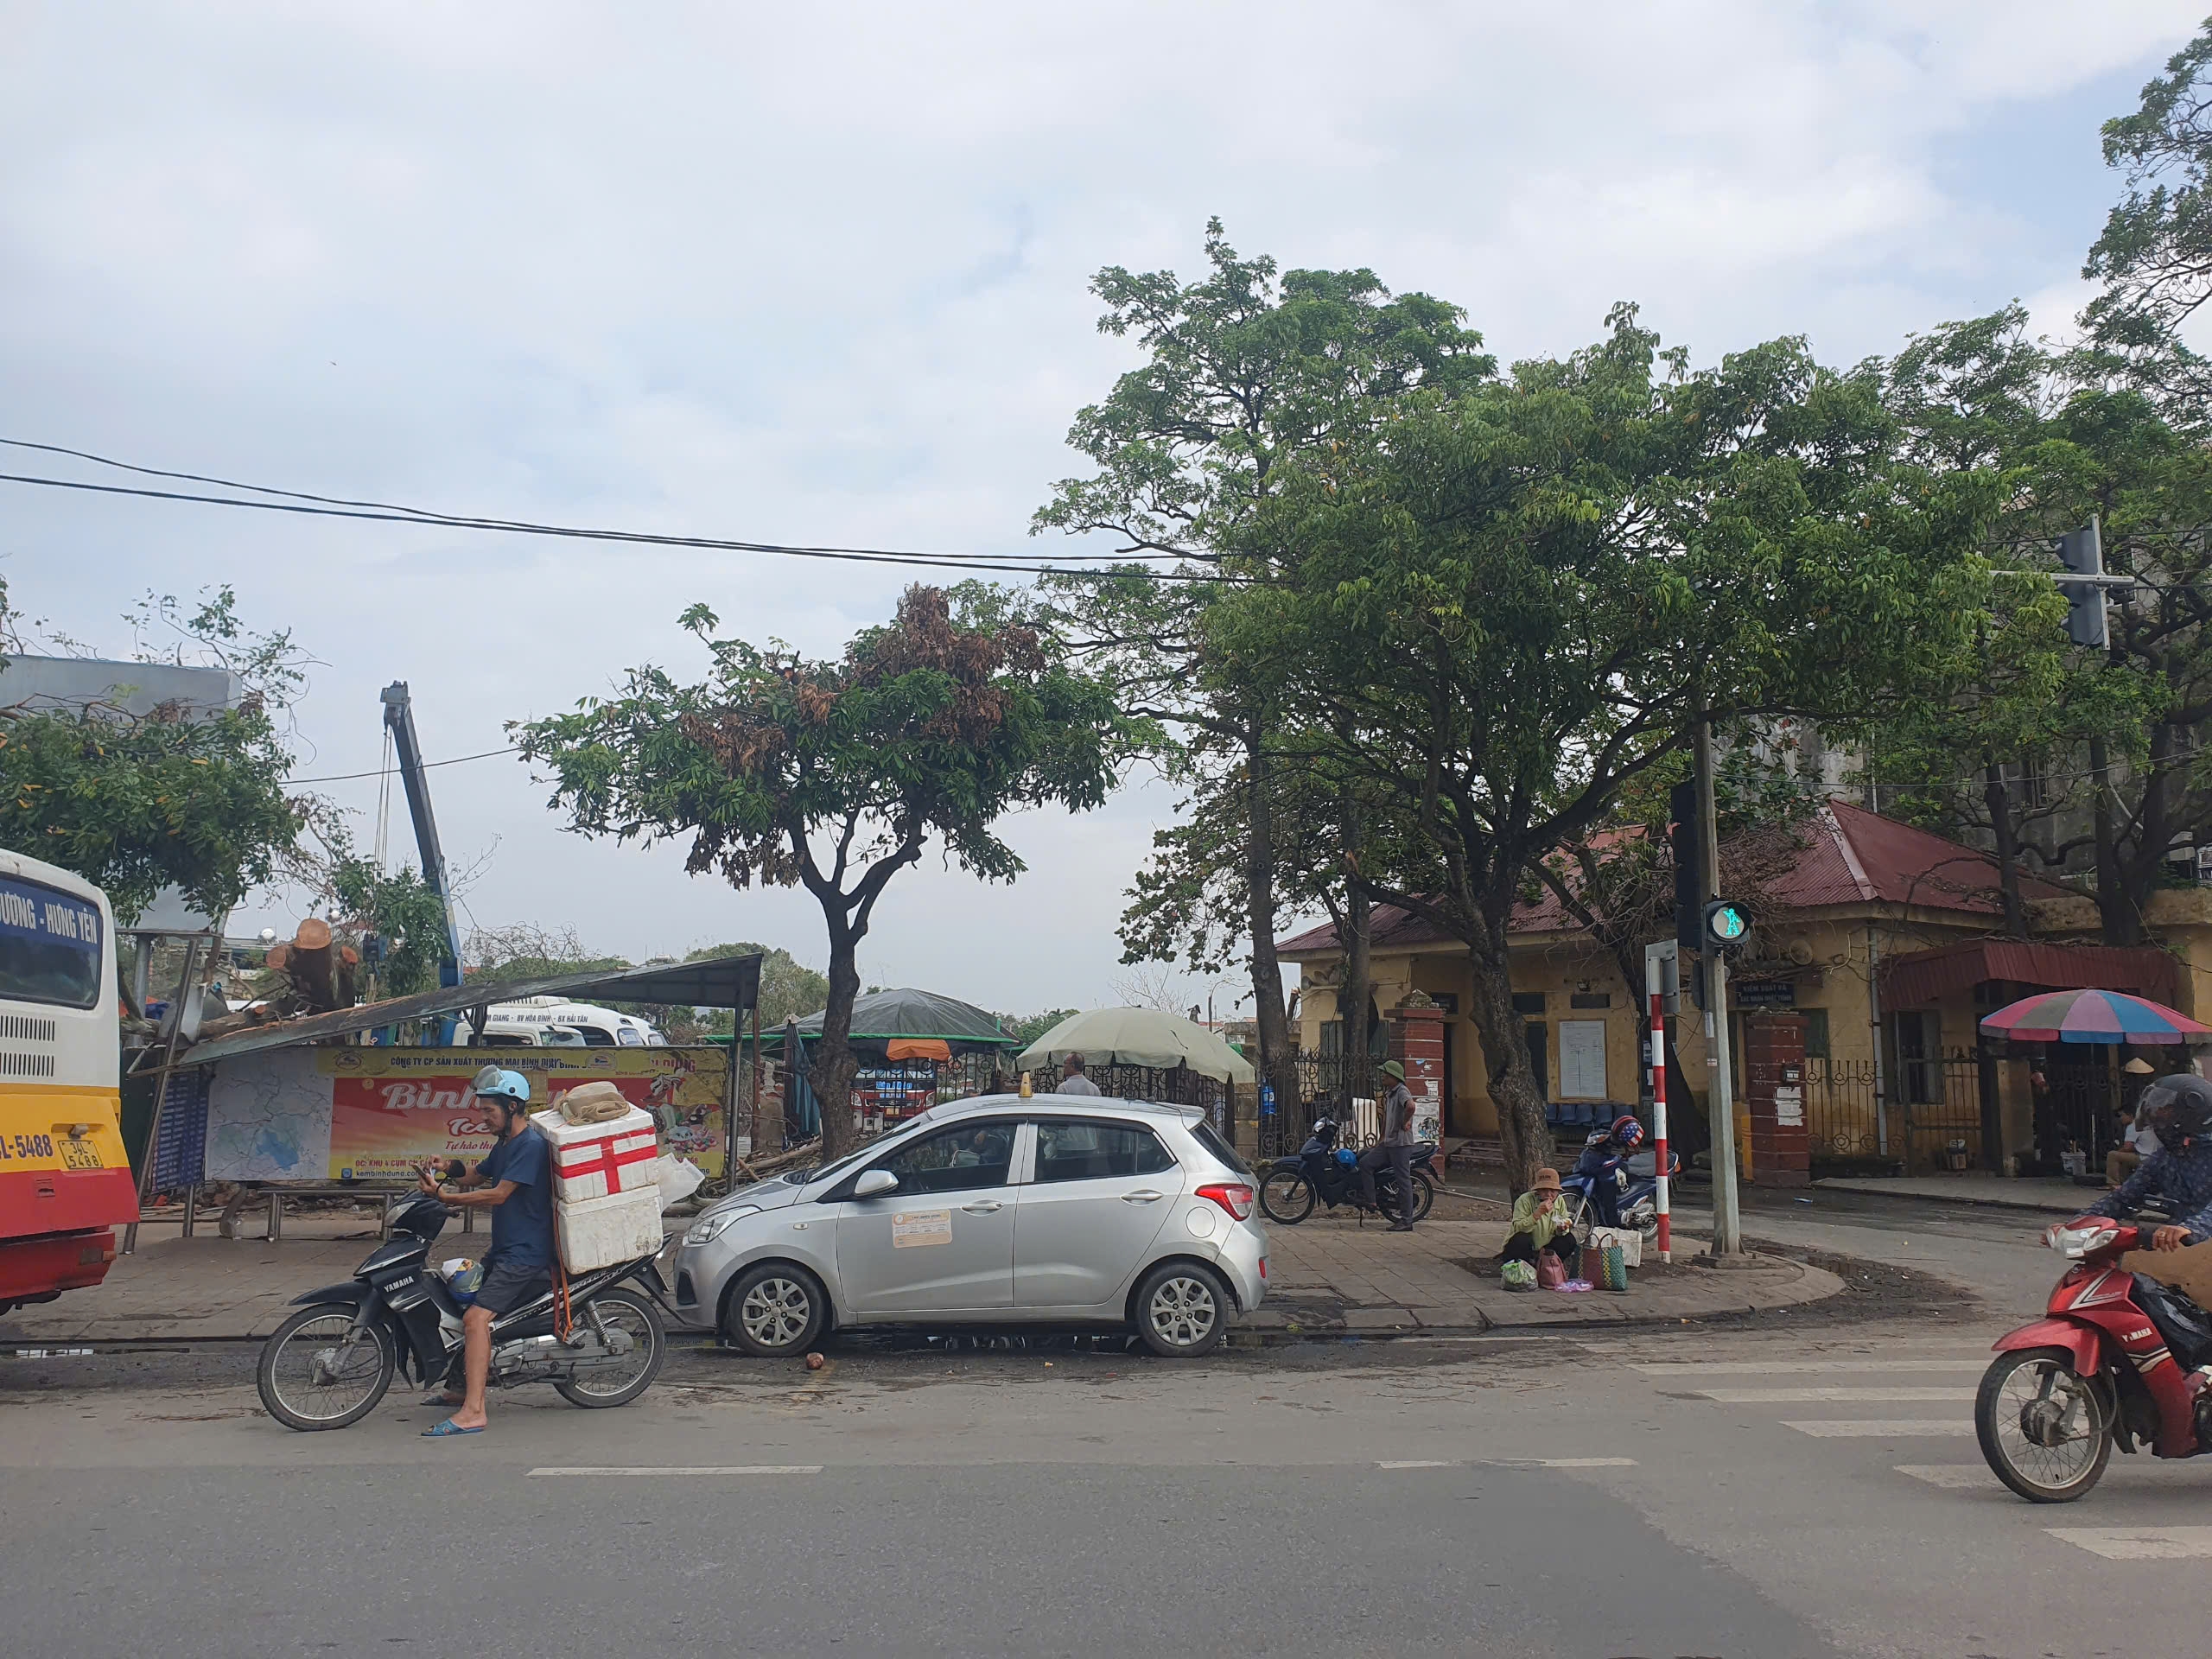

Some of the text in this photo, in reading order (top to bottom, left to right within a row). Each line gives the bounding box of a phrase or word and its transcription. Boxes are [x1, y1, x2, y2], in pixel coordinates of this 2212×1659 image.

[45, 903, 76, 939] HƯNG
[77, 907, 98, 944] YÊN
[413, 1057, 422, 1065] TY
[70, 1142, 88, 1155] 34L
[68, 1155, 99, 1167] 5488
[384, 1275, 415, 1293] YAMAHA
